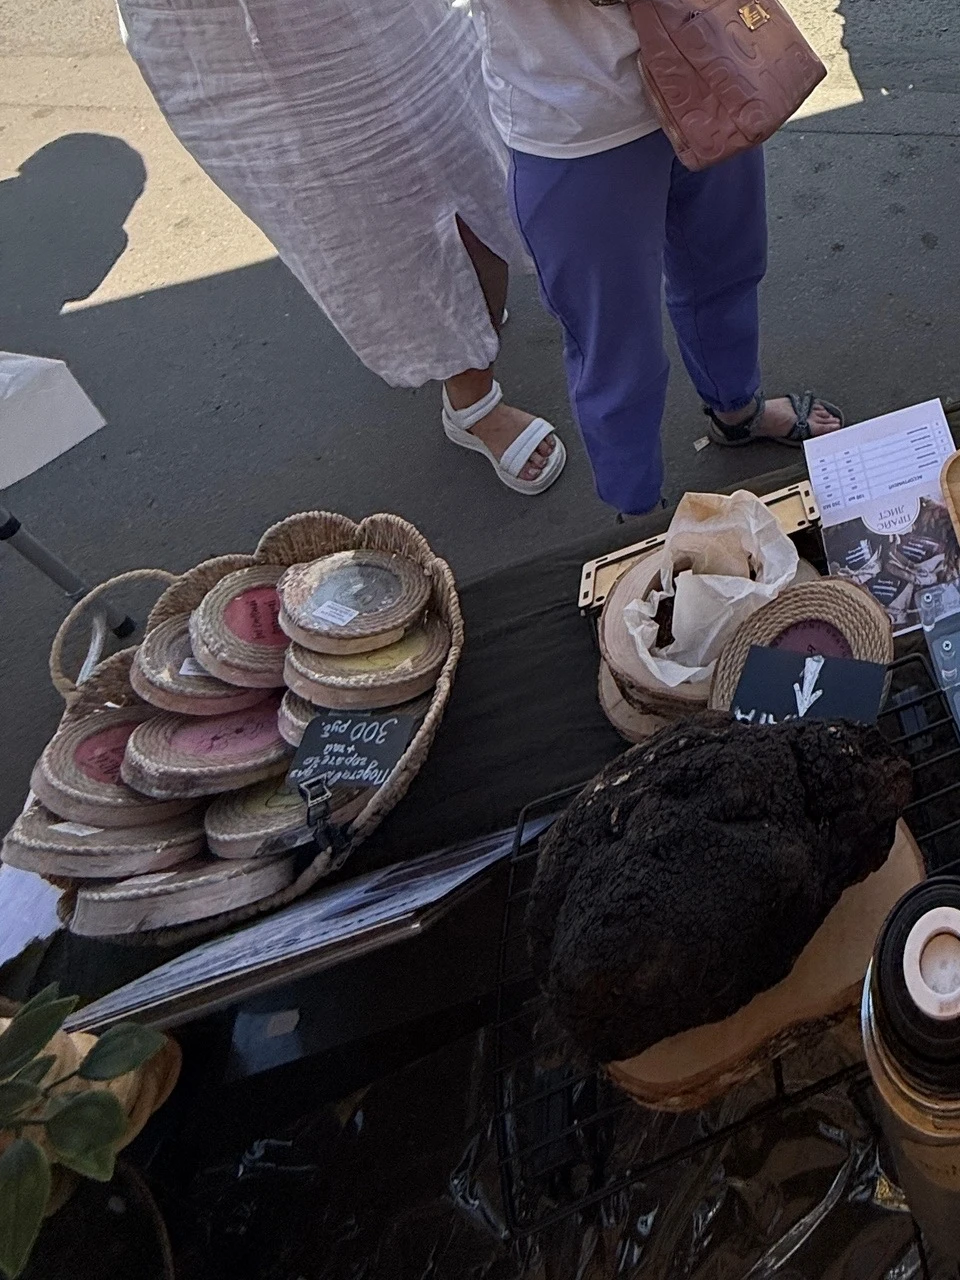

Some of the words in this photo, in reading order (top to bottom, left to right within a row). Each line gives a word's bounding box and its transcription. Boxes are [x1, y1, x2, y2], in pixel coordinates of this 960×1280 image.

[878, 504, 904, 519] ЛИСТ
[876, 514, 911, 531] ПРАЙС
[320, 719, 352, 738] руб.
[349, 717, 399, 744] 300
